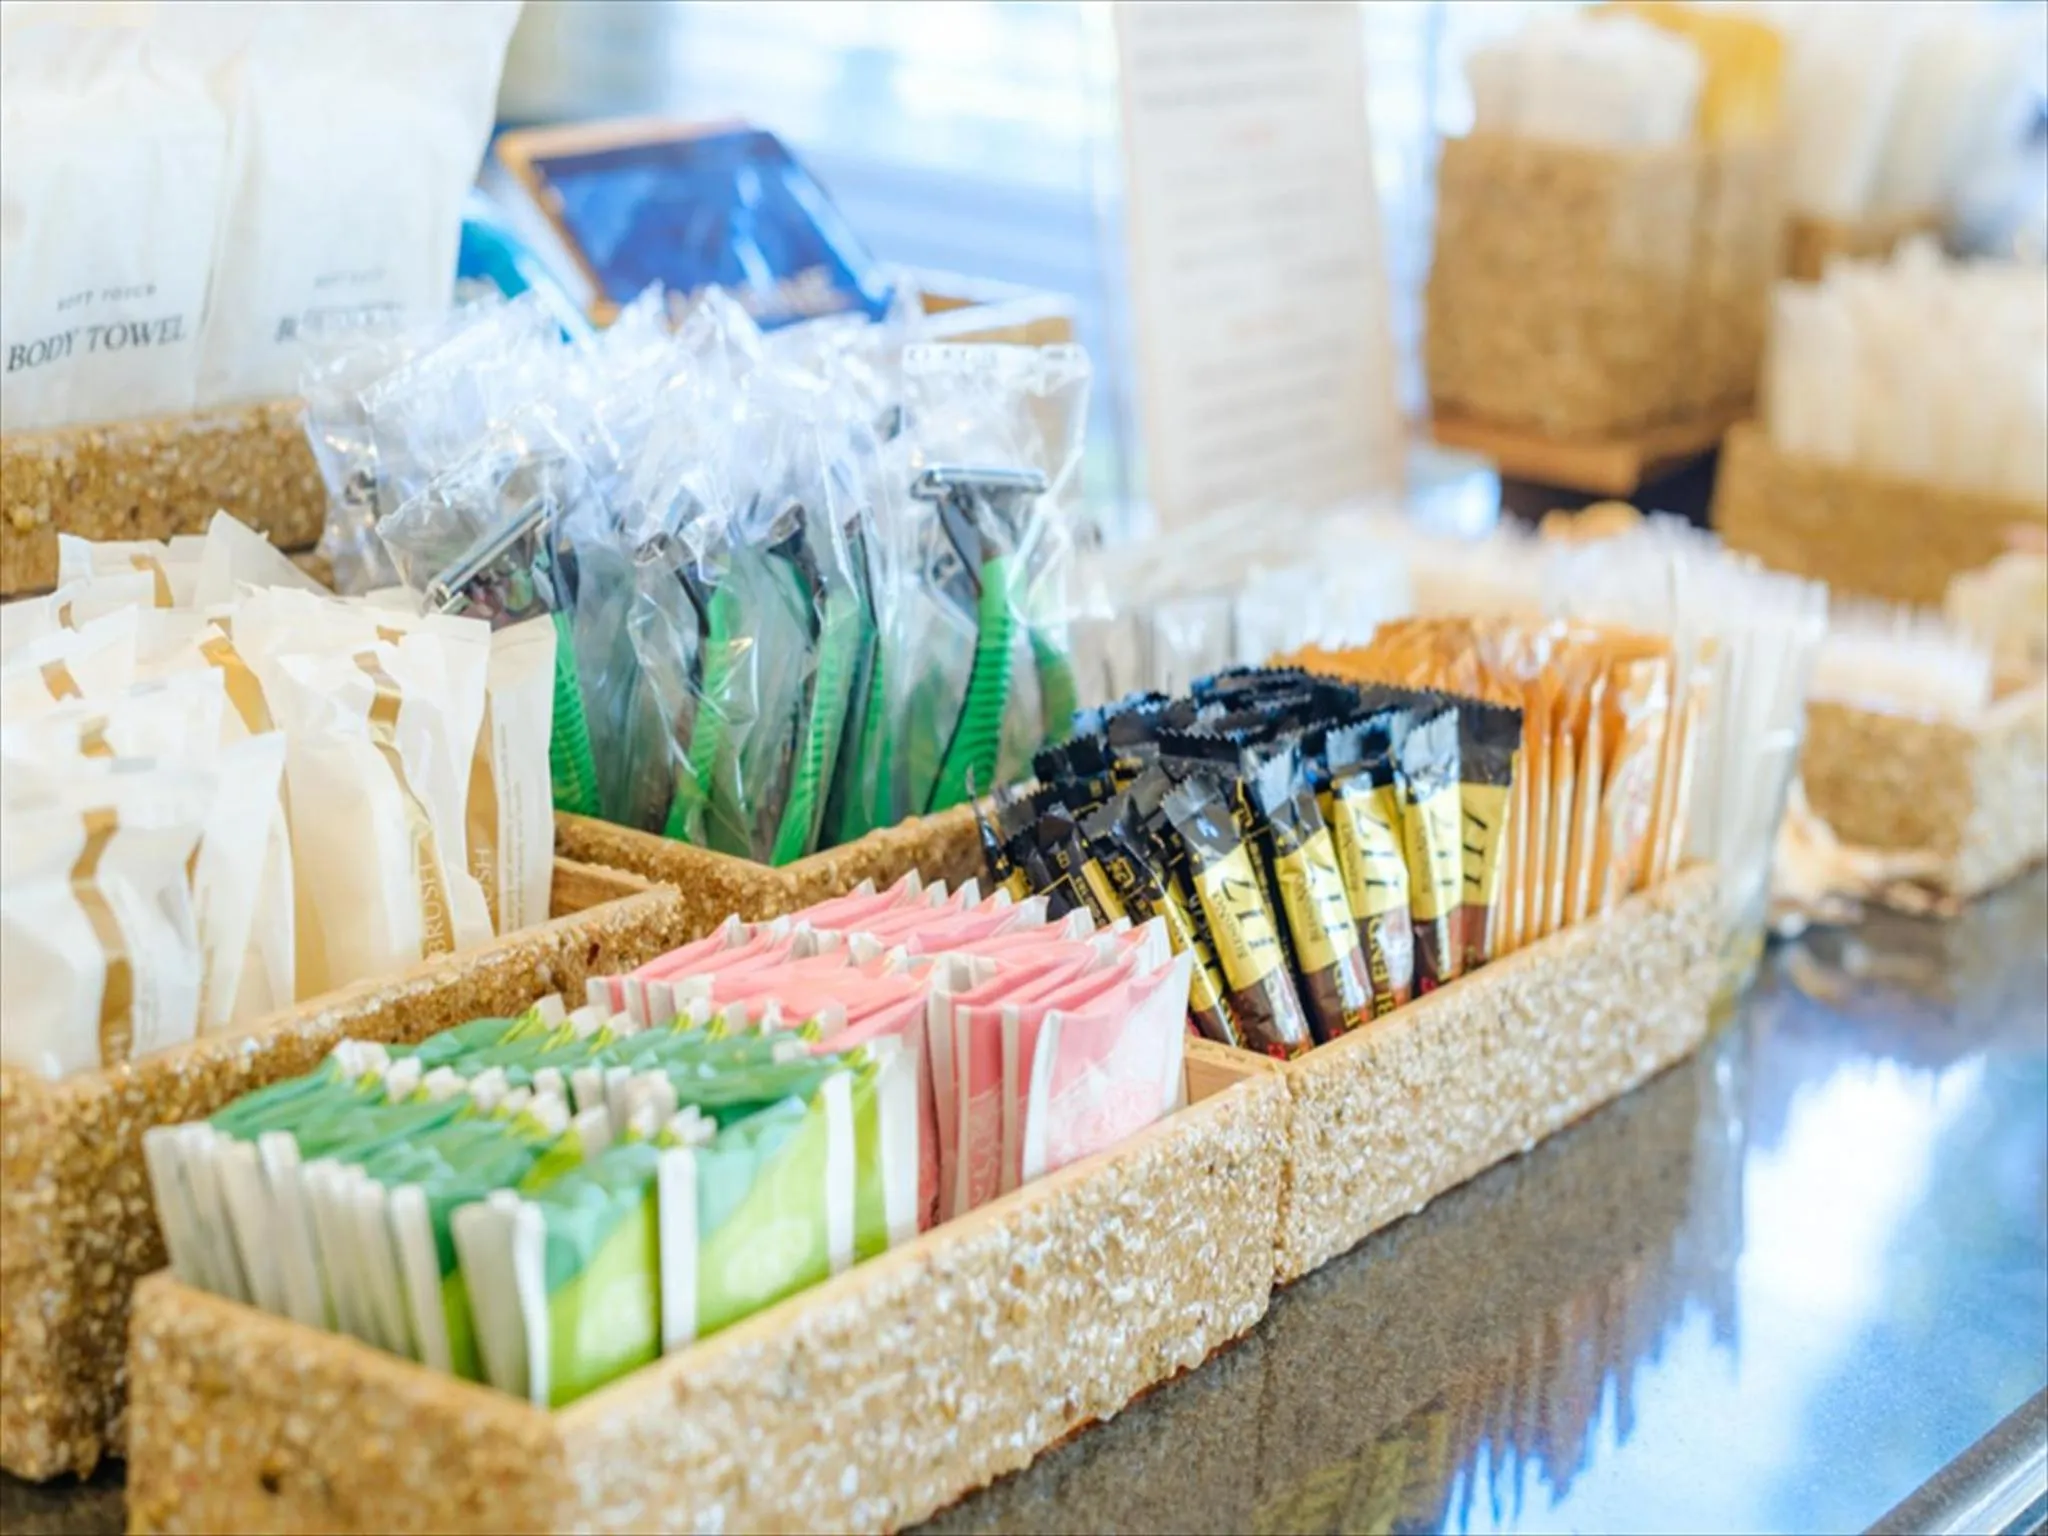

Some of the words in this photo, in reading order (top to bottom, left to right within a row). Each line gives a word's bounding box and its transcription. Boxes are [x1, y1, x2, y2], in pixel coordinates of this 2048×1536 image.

[7, 327, 80, 373] BODY
[87, 314, 186, 351] TOWEL
[1221, 877, 1274, 947] 117
